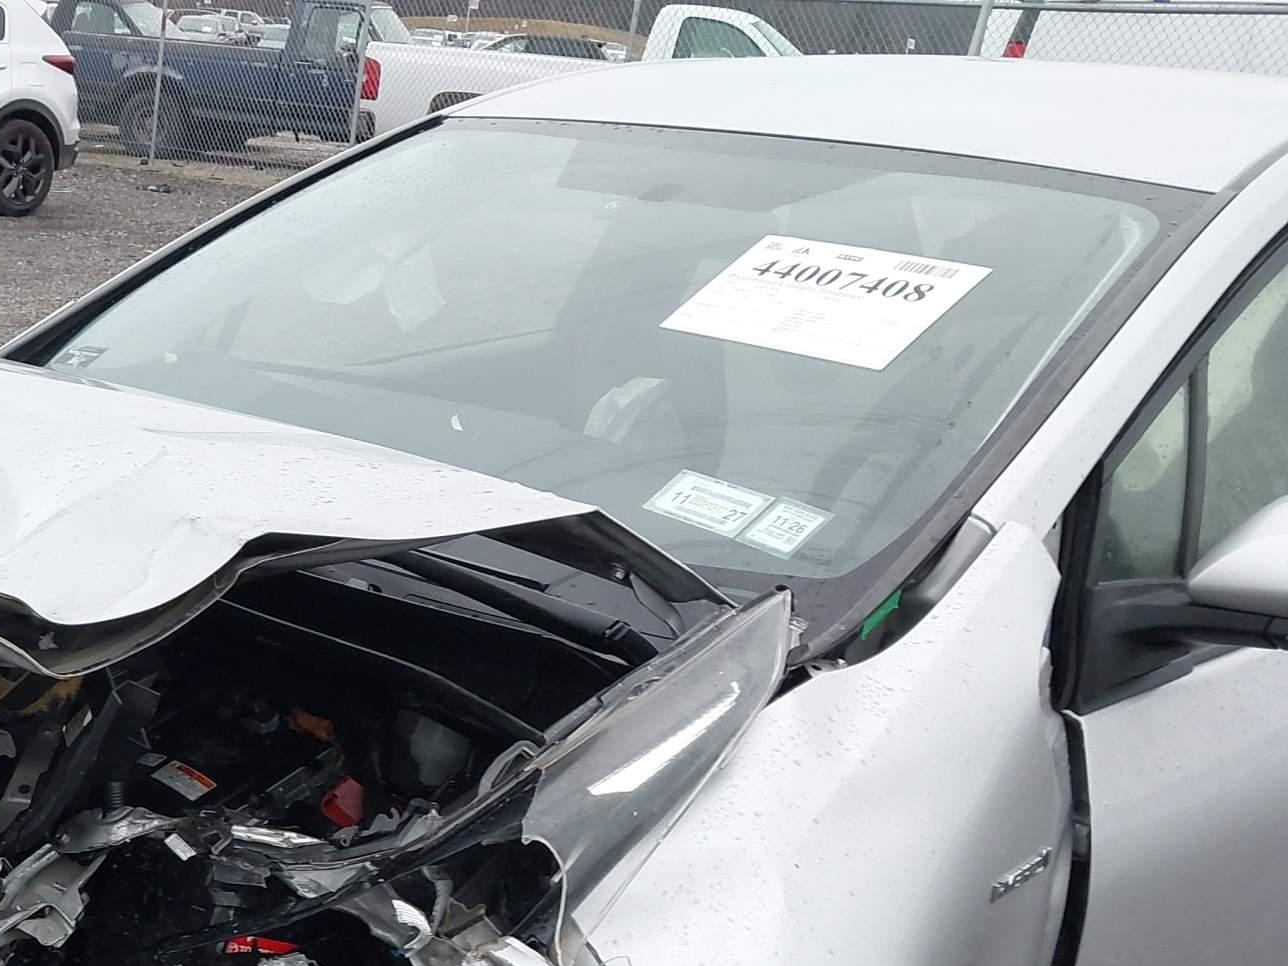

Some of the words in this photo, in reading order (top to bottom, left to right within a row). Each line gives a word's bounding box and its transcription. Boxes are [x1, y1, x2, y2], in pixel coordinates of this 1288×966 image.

[752, 259, 935, 303] 44007408
[671, 491, 689, 504] 11
[722, 509, 747, 523] 27
[774, 514, 790, 527] 11
[789, 520, 808, 535] 26
